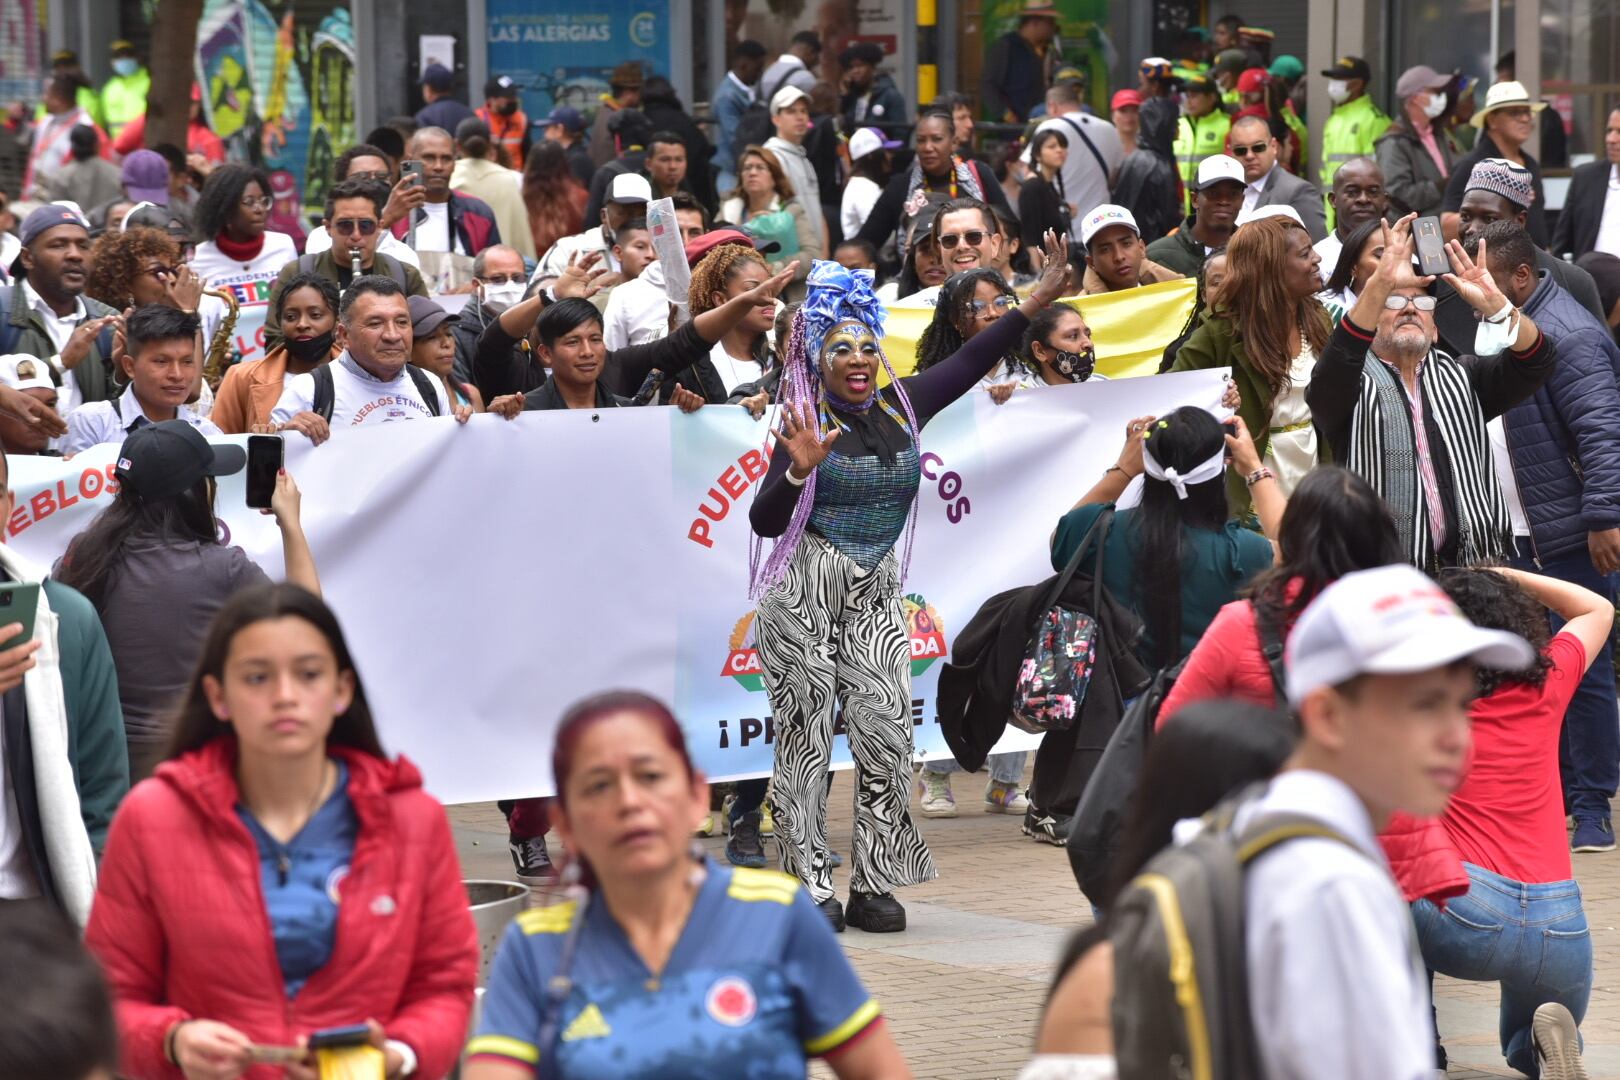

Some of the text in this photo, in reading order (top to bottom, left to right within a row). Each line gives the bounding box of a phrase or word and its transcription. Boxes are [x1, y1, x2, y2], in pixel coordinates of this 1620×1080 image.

[489, 24, 612, 42] LAS ALERGIAS
[213, 271, 280, 287] PRESIDENT
[395, 395, 432, 418] ÉTNICO
[5, 463, 120, 541] EBLOS
